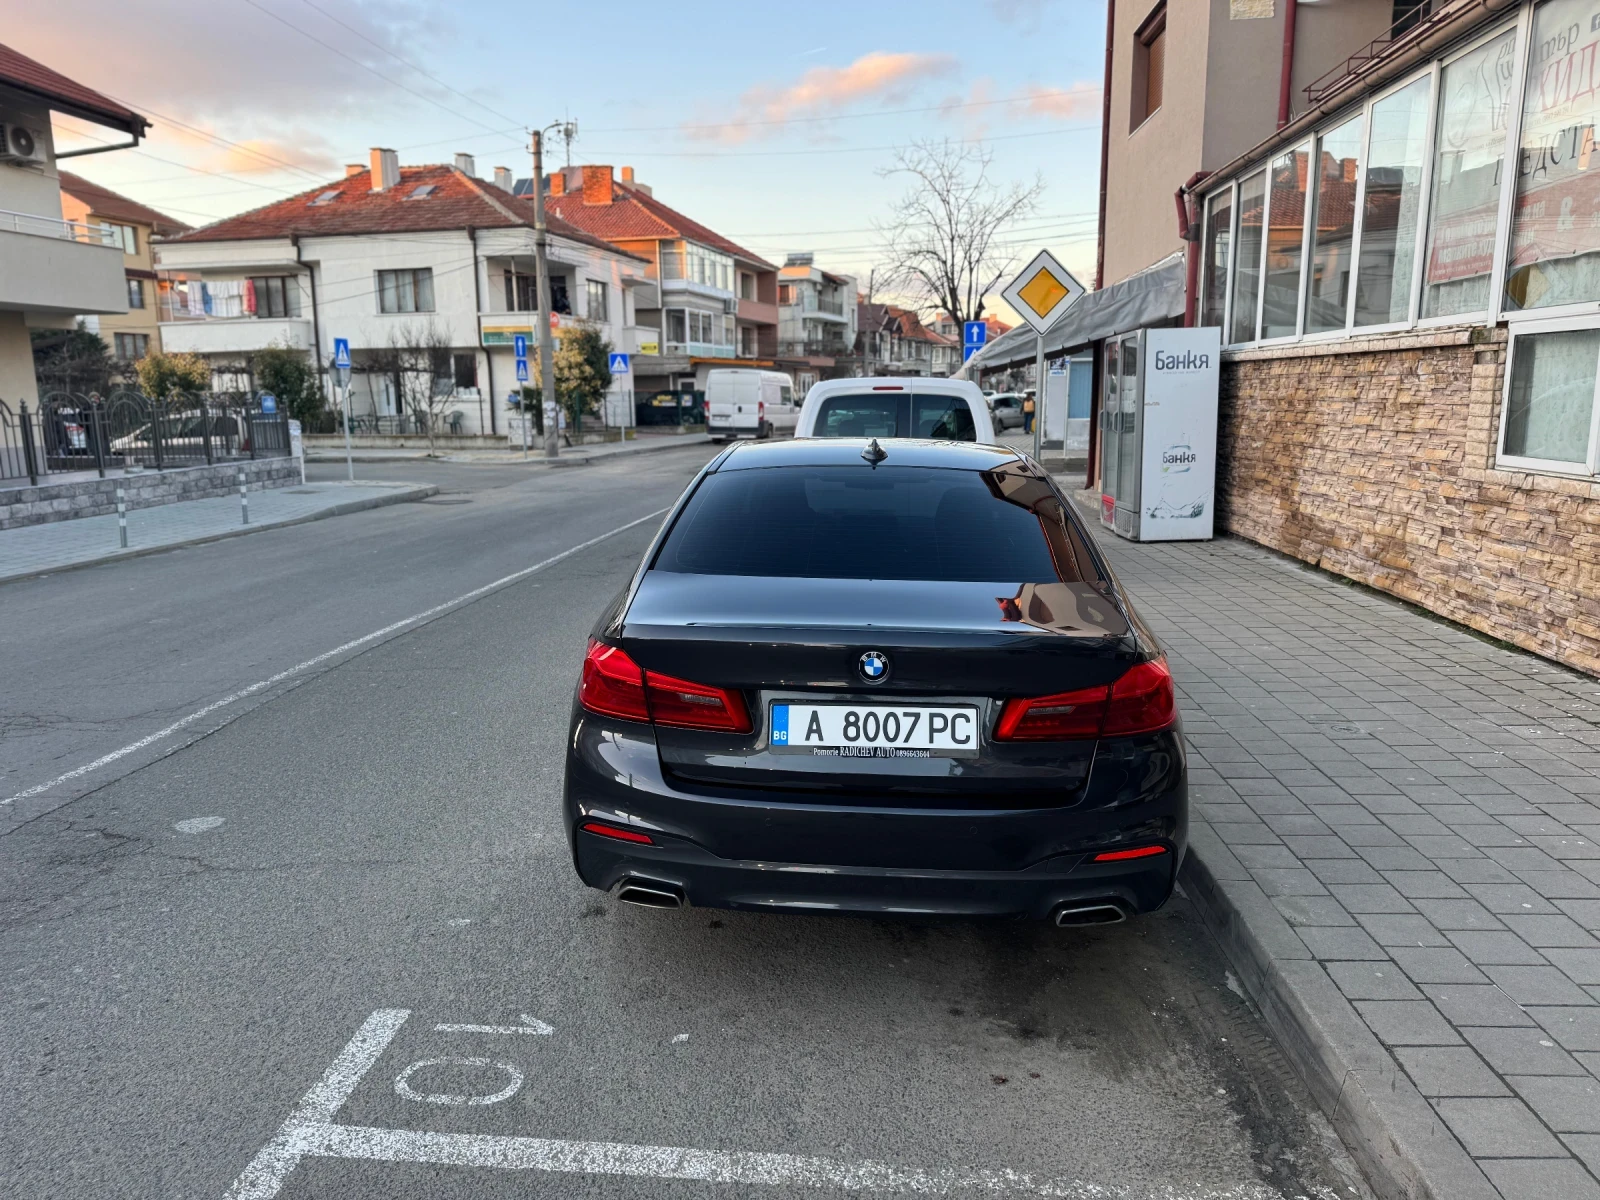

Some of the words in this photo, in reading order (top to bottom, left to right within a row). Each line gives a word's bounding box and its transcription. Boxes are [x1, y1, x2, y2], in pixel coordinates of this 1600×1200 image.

[1155, 349, 1209, 371] Банкя
[1163, 452, 1196, 463] Банкя
[804, 710, 824, 742] A
[843, 711, 921, 743] 8007
[928, 712, 971, 744] PC
[773, 730, 787, 740] BG
[813, 748, 839, 757] Pomorie
[839, 747, 875, 757] RADICHEV
[876, 747, 896, 758] AUTO
